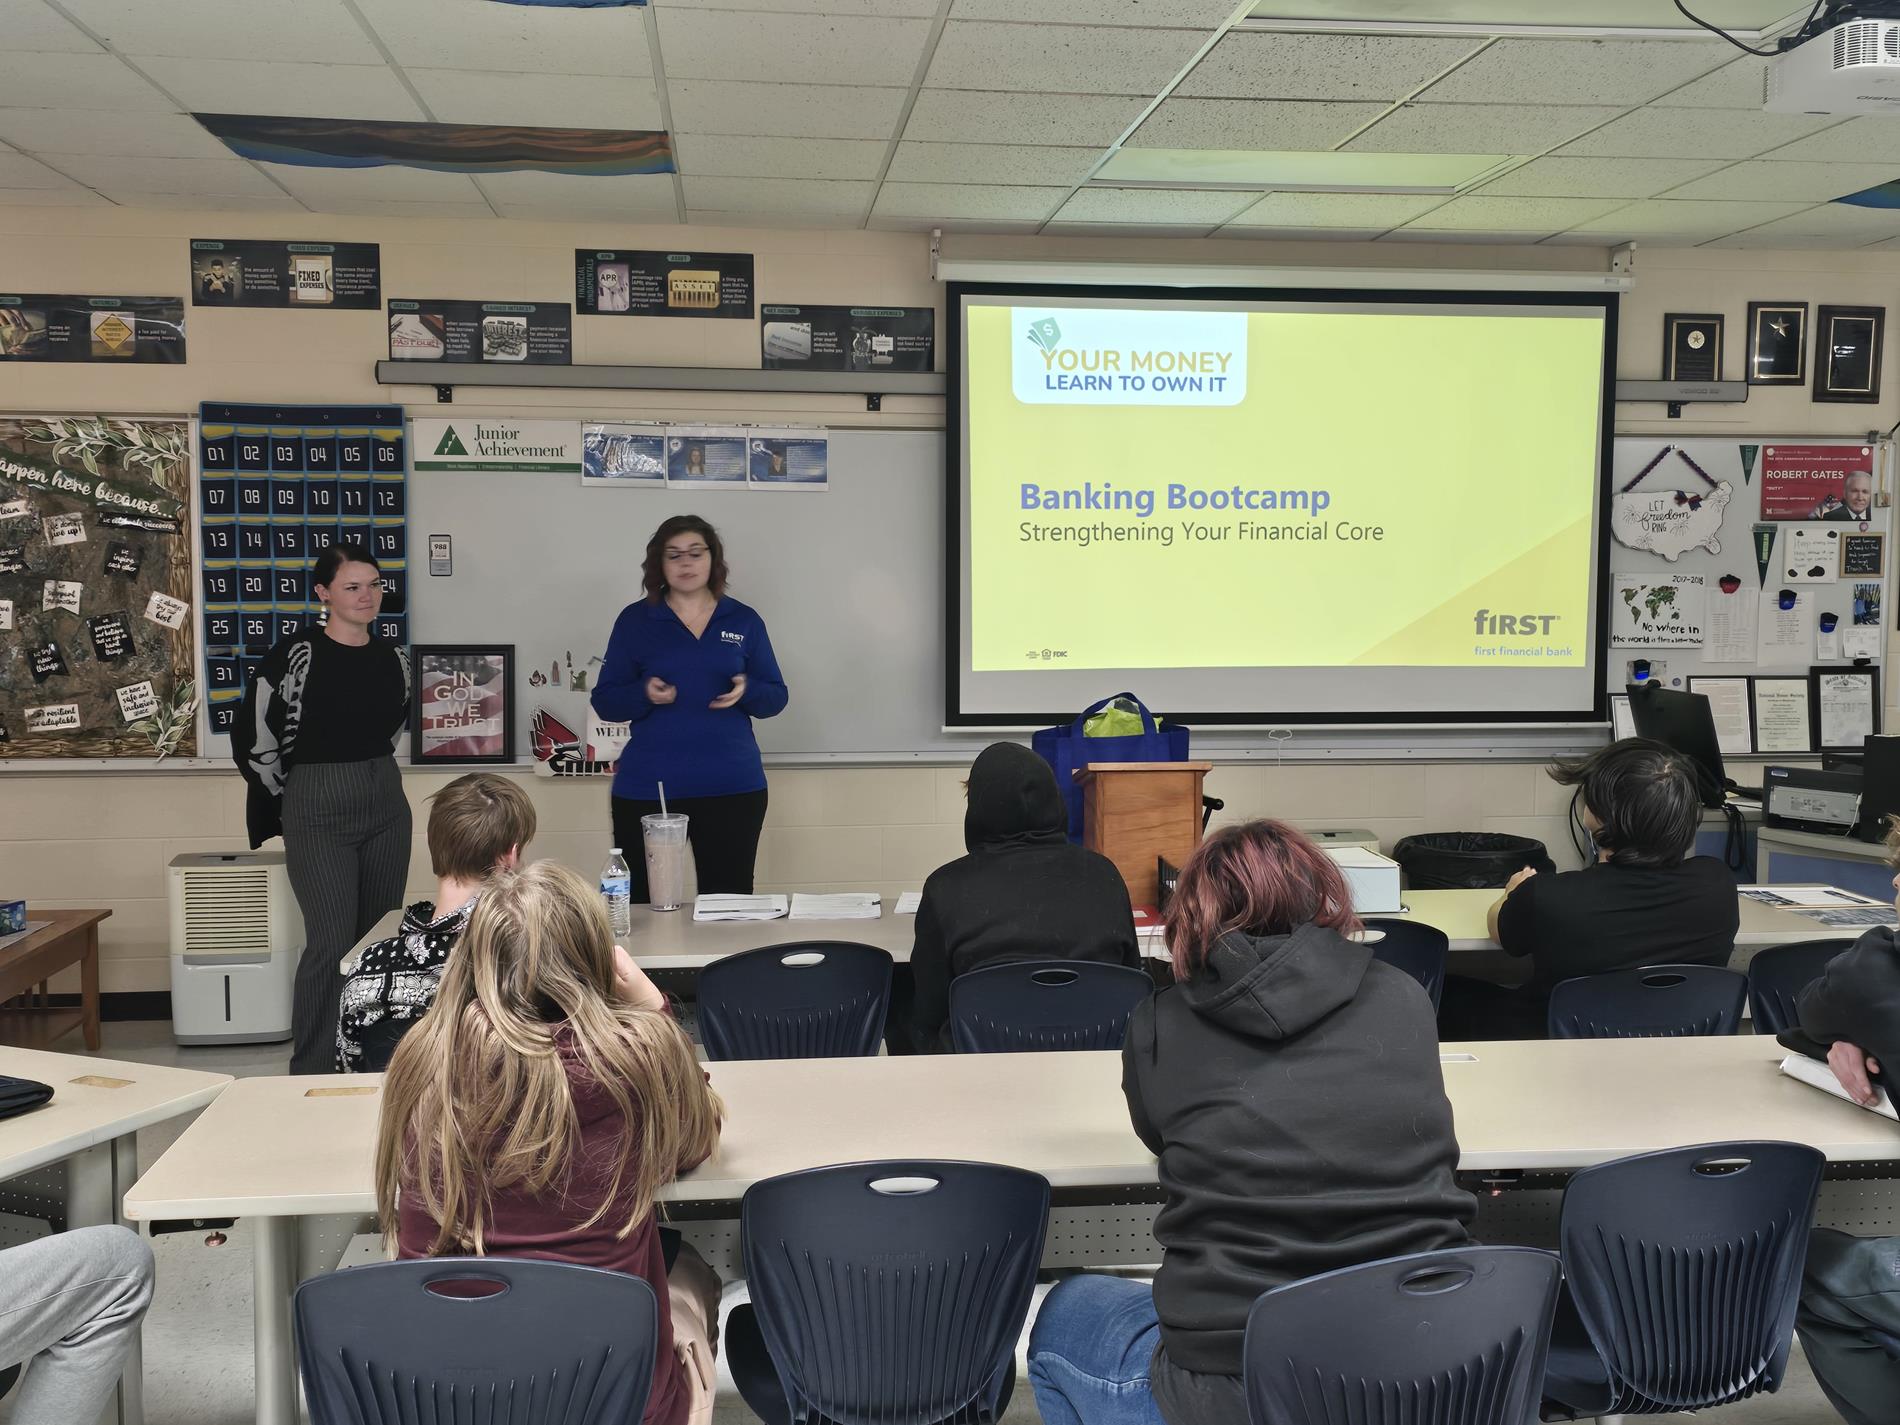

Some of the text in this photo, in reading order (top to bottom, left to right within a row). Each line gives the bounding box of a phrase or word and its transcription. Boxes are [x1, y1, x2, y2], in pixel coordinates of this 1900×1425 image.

[298, 270, 320, 281] FIXED
[1040, 348, 1232, 373] YOUR MONEY
[1046, 374, 1227, 392] LEARN TO OWN IT
[474, 424, 520, 441] Junior
[208, 448, 225, 461] 01
[243, 446, 260, 460] 02
[277, 447, 293, 461] 03
[310, 448, 327, 462] 04
[344, 448, 361, 462] 05
[378, 448, 395, 462] 06
[474, 441, 565, 457] Achievement
[1766, 470, 1844, 479] ROBERT GATES
[52, 470, 91, 495] here
[209, 490, 225, 504] 07
[244, 489, 260, 504] 08
[278, 490, 294, 505] 09
[313, 490, 329, 505] 10
[345, 491, 362, 506] 11
[378, 491, 395, 506] 12
[1020, 482, 1331, 518] Banking Bootcamp
[1648, 500, 1664, 511] LET
[1640, 509, 1691, 532] freedom
[1652, 522, 1667, 532] RING
[210, 532, 227, 547] 13
[246, 532, 262, 547] 14
[278, 533, 295, 548] 15
[345, 534, 362, 545] 17
[1019, 521, 1384, 546] Strengthening Your Financial Core
[313, 534, 329, 548] 16
[379, 535, 396, 550] 18
[209, 578, 226, 593] 19
[245, 578, 262, 592] 20
[280, 579, 297, 593] 21
[381, 579, 396, 593] 24
[1672, 575, 1704, 585] 2017-2018
[156, 610, 172, 623] best
[212, 620, 229, 635] 25
[247, 620, 264, 635] 26
[282, 620, 298, 635] 27
[382, 623, 398, 637] 30
[1642, 622, 1700, 634] No where in
[1612, 635, 1625, 643] the
[1474, 646, 1572, 656] first financial bank
[36, 662, 59, 672] things
[216, 667, 233, 681] 31
[452, 671, 474, 686] IN
[139, 690, 149, 698] and
[434, 685, 484, 701] GOD
[47, 706, 76, 717] resilient
[123, 700, 155, 712] inclusive
[446, 702, 480, 717] WE
[41, 716, 77, 726] adaptable
[218, 710, 233, 724] 37
[428, 718, 500, 730] TRUST
[596, 728, 614, 736] WE
